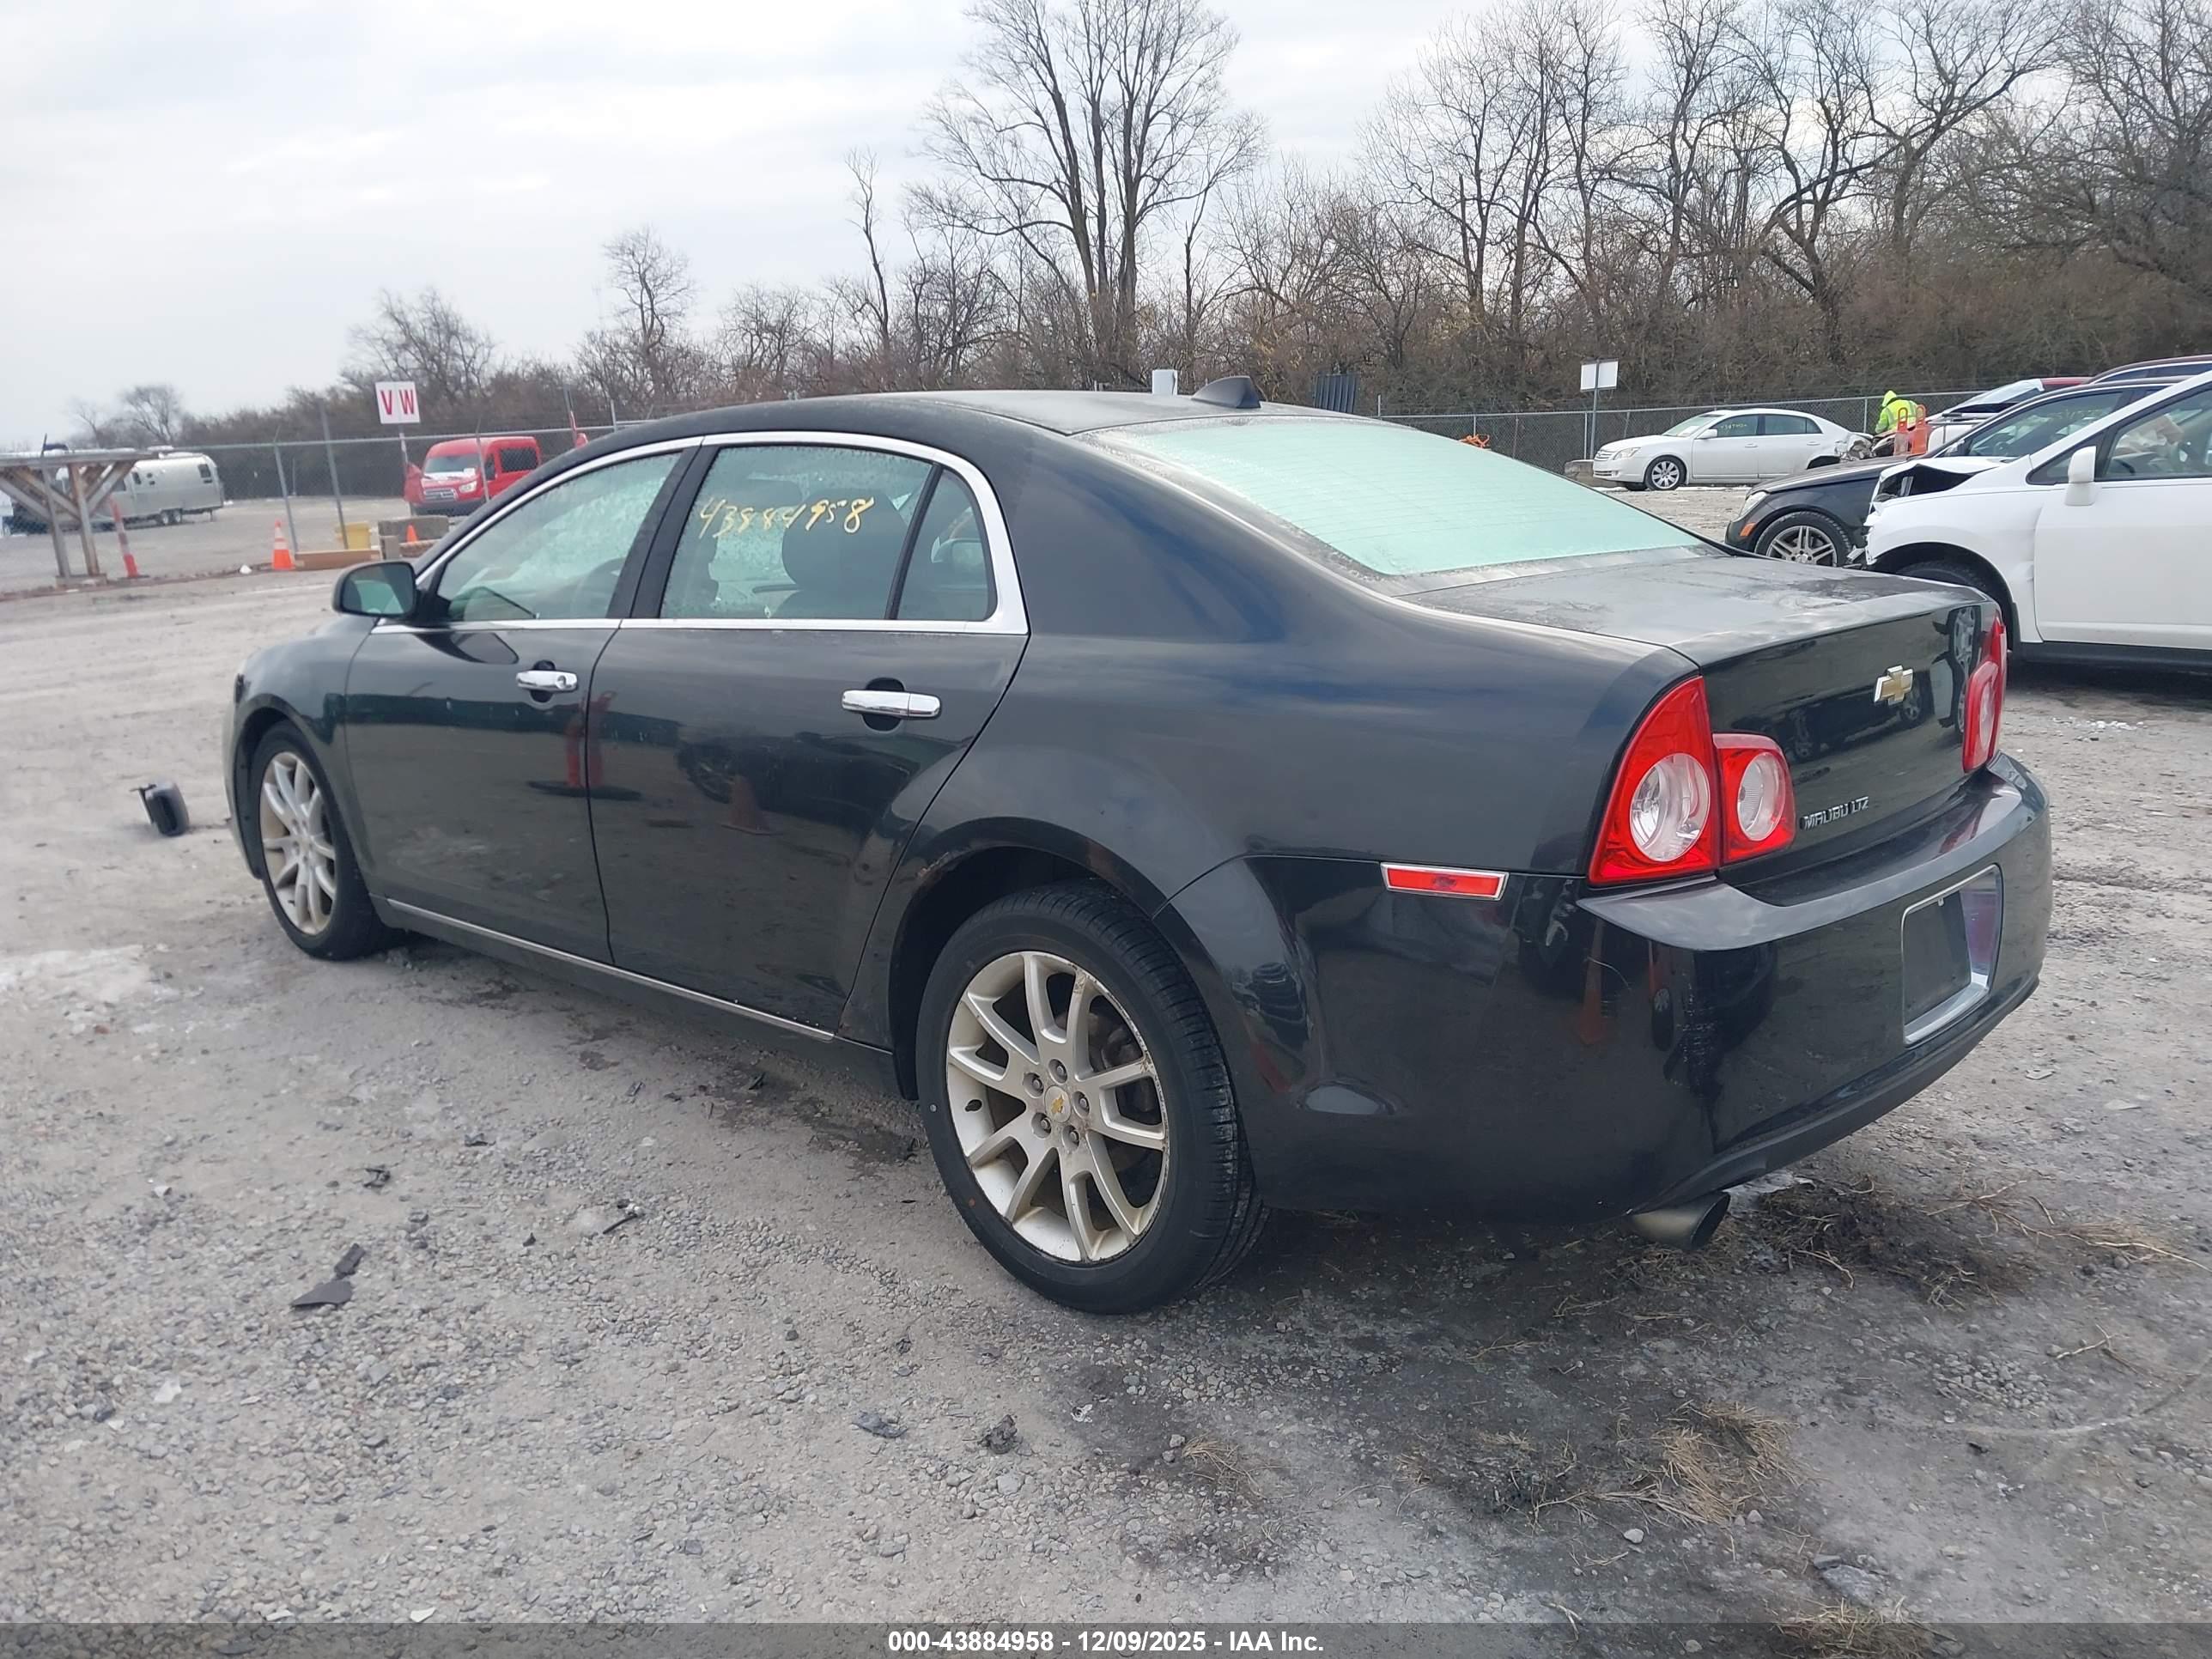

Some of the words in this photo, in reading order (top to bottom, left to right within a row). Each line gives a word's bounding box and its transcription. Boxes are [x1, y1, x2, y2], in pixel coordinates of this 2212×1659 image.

[698, 495, 874, 539] 43884958
[1802, 802, 1850, 830] MALIBU
[1850, 795, 1869, 814] LTZ
